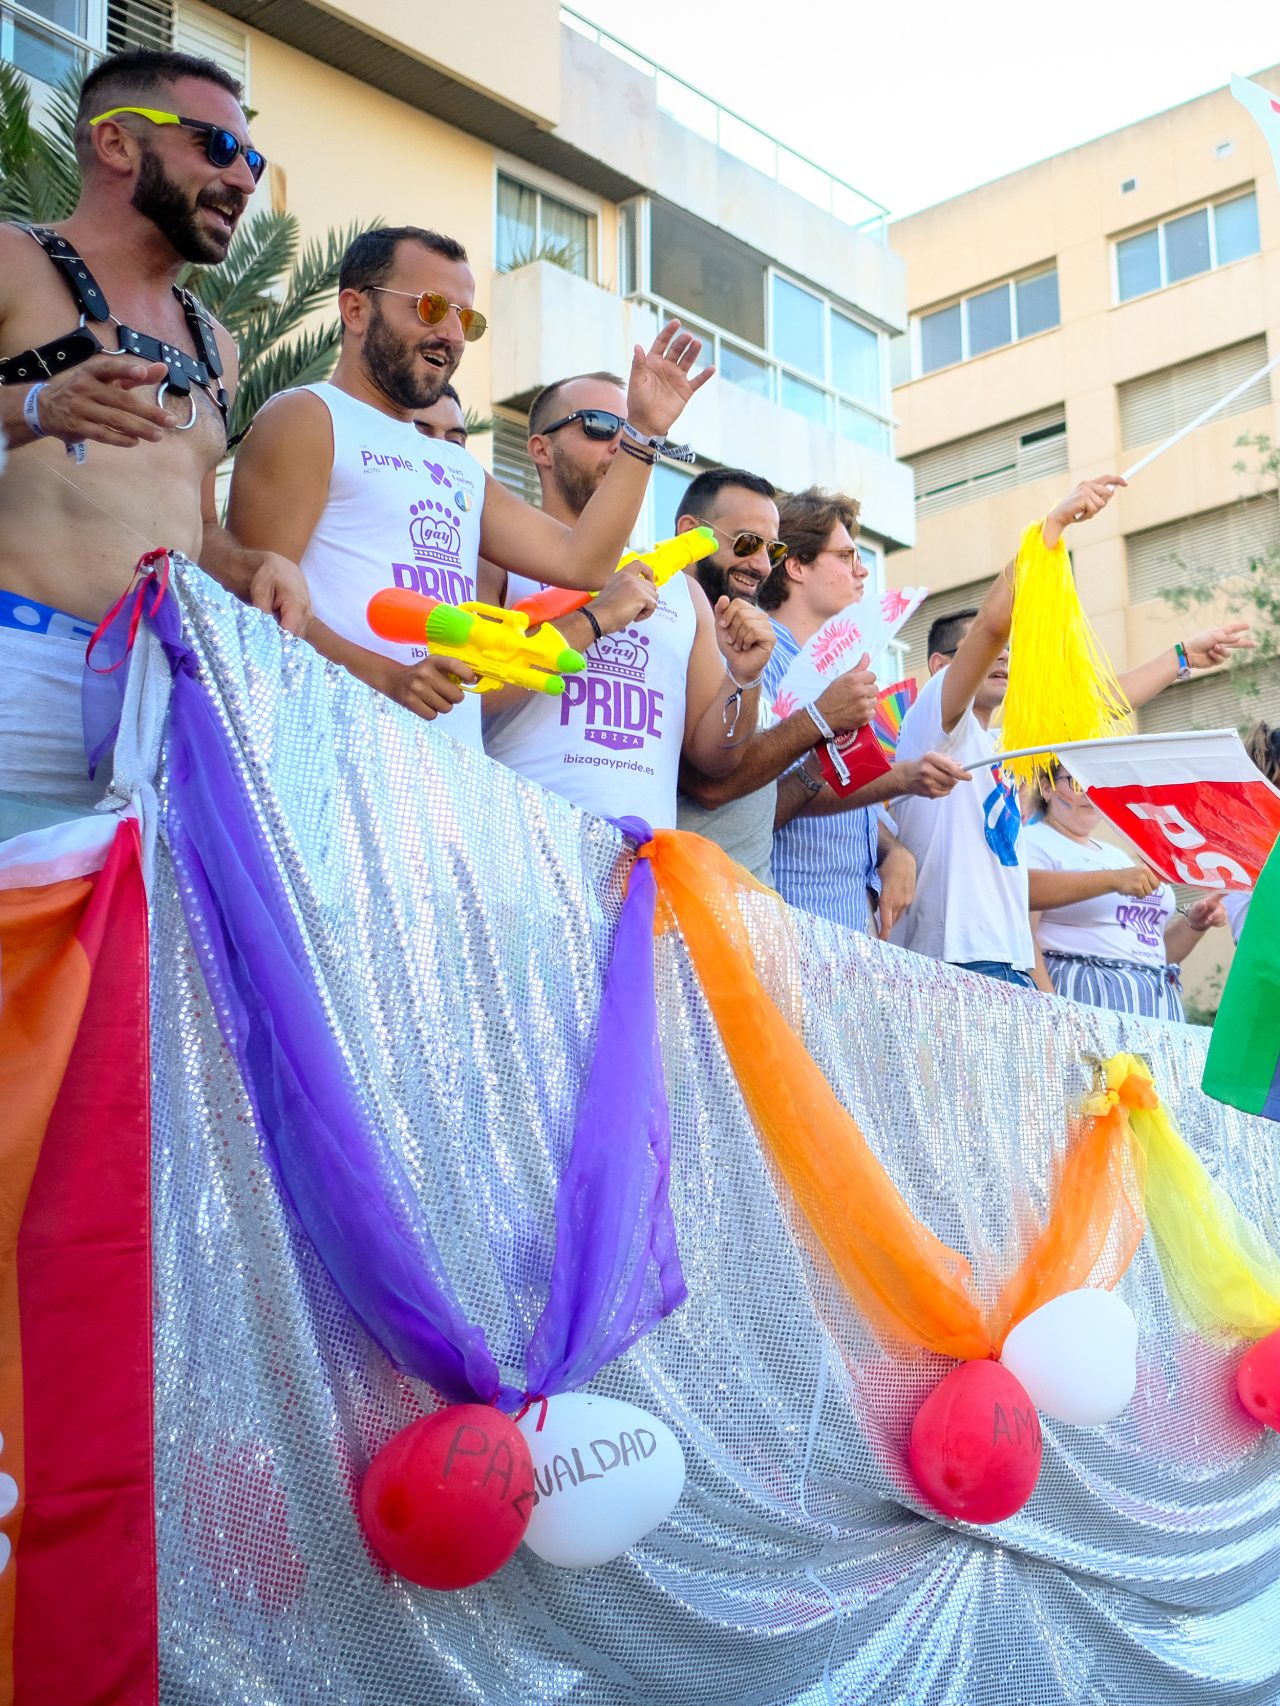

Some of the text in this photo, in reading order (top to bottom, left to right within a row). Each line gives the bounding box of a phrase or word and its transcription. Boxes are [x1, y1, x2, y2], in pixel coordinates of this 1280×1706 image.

[424, 529, 449, 544] gay
[601, 643, 634, 660] gay
[560, 675, 664, 739] PRIDE
[589, 731, 639, 746] IBIZA
[563, 753, 655, 775] ibizagaypride.es
[533, 1428, 657, 1497] UALDAD
